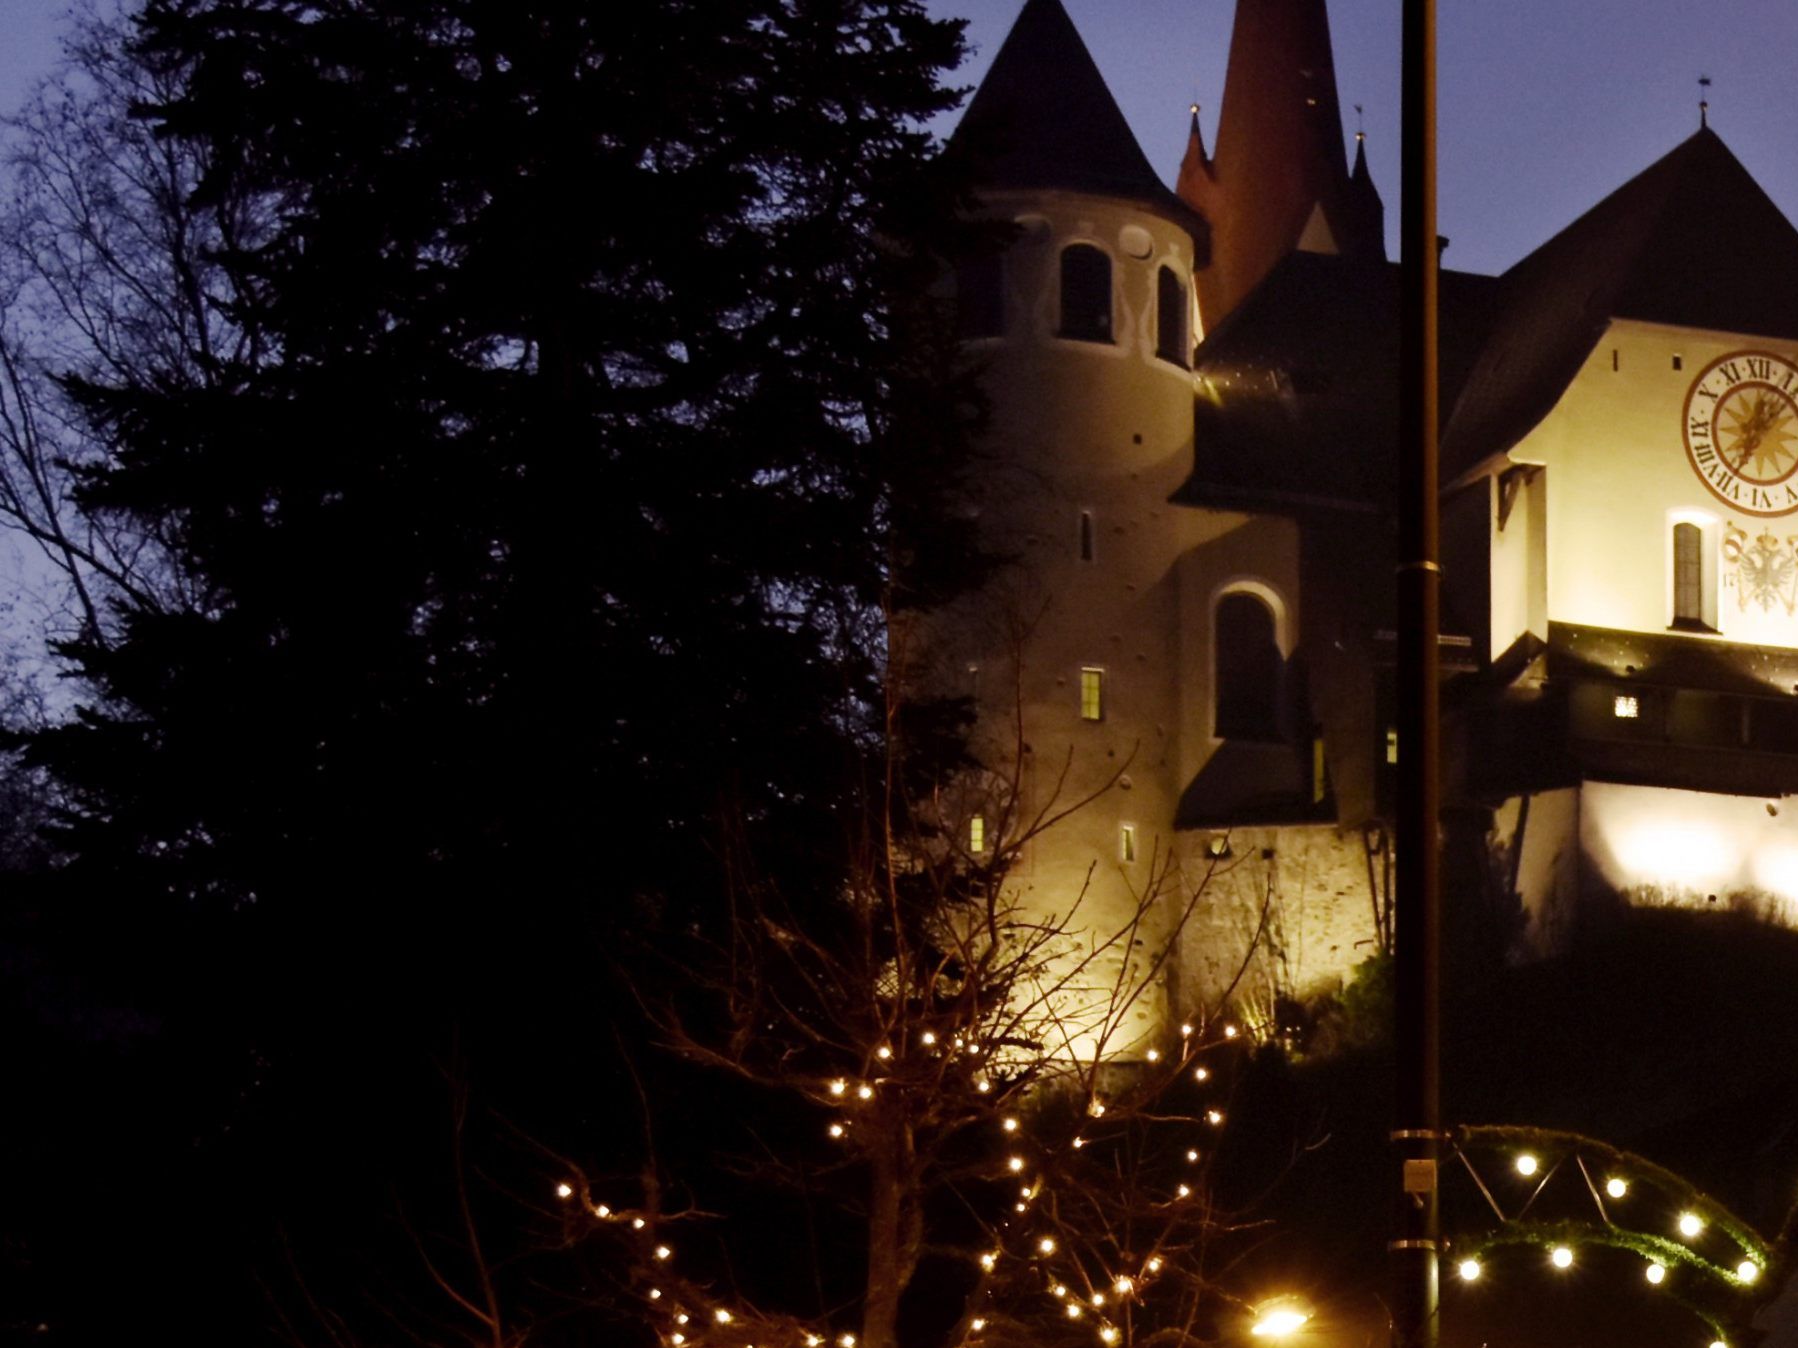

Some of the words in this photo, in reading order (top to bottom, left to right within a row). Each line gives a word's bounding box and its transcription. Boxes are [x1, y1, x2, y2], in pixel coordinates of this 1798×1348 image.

[1719, 362, 1741, 386] XI
[1746, 358, 1771, 380] XII
[1698, 383, 1719, 404] X
[1690, 416, 1710, 439] IX
[1751, 487, 1772, 509] VI
[1784, 484, 1798, 505] V
